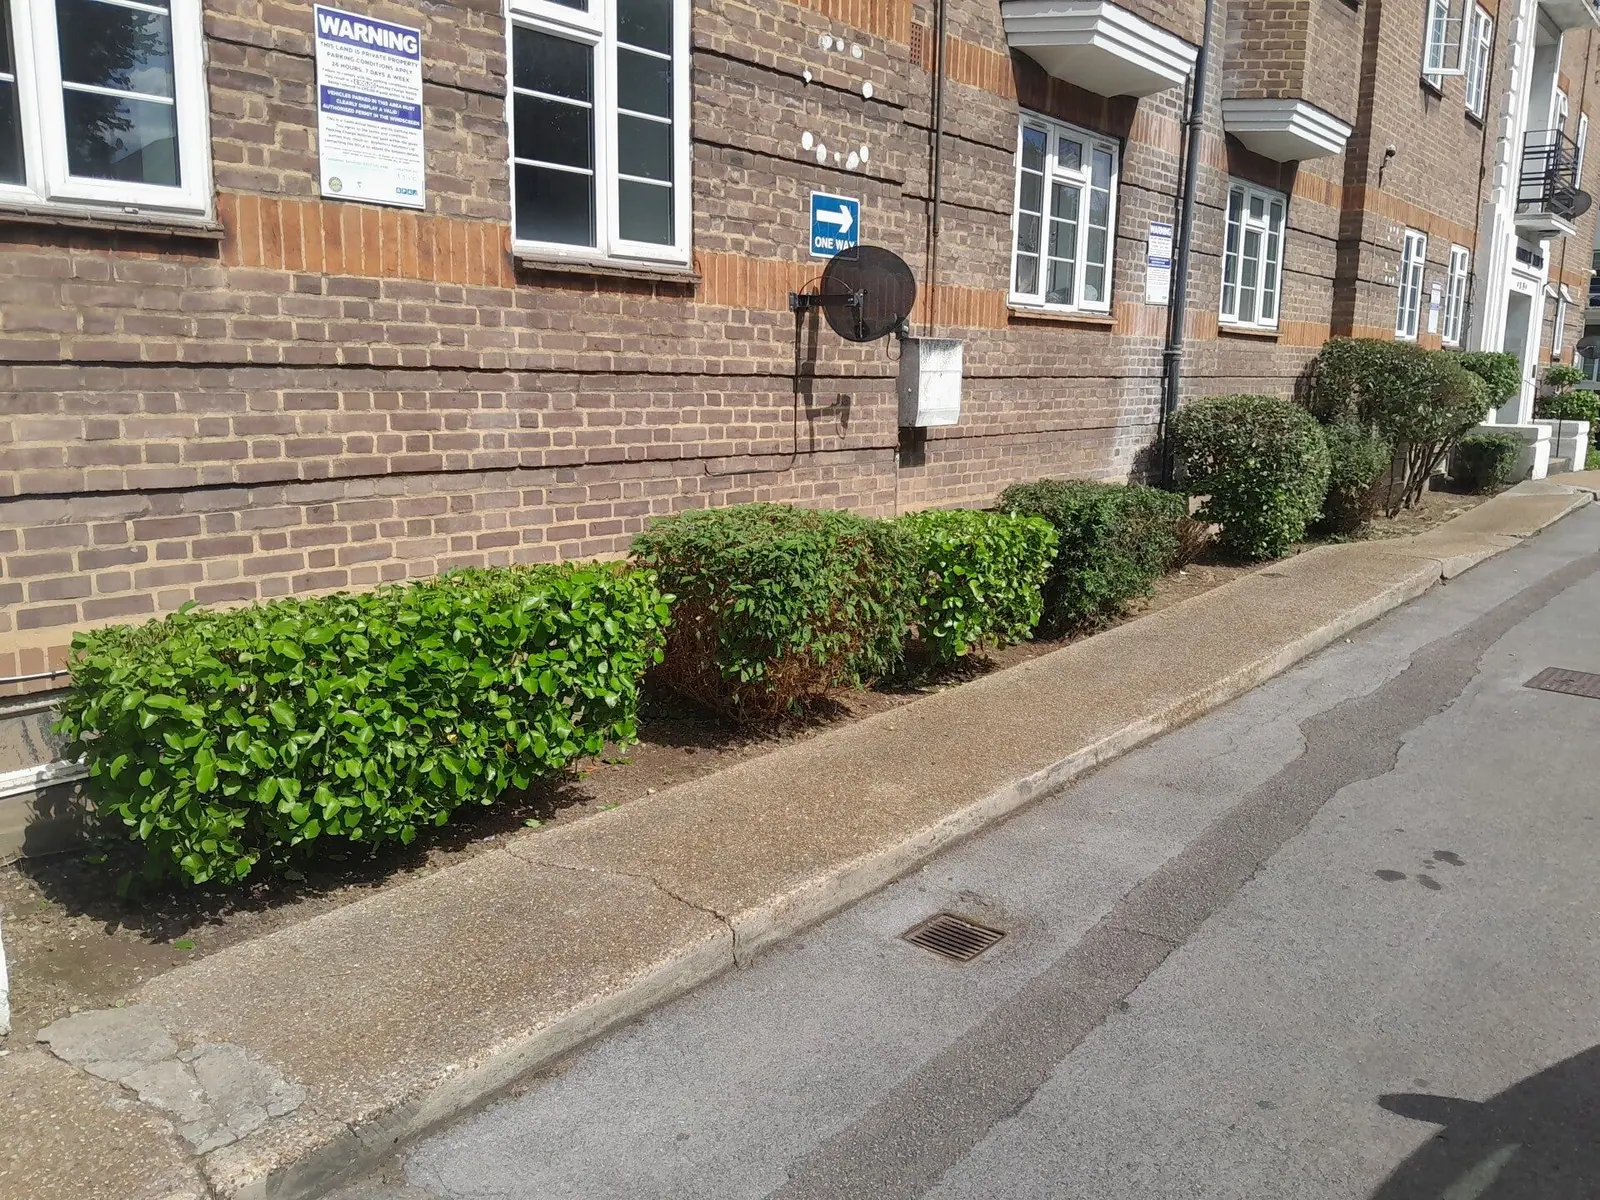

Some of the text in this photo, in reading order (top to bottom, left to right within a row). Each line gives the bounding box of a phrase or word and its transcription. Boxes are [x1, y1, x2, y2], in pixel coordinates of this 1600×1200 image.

[318, 13, 418, 54] WARNING
[320, 41, 334, 49] THIS
[335, 44, 353, 53] LAND
[361, 50, 386, 60] PRIVATE
[387, 56, 418, 68] PROPERTY
[326, 51, 412, 75] PARKING CONDITIONS APPLY
[370, 69, 385, 77] DAYS
[392, 74, 410, 83] WEEK
[327, 89, 351, 98] VEHICLES
[352, 94, 371, 103] PARKED
[402, 104, 416, 112] MUST
[335, 98, 358, 107] CLEARLY
[358, 102, 379, 111] DISPLAY
[383, 107, 398, 115] VALID
[322, 103, 355, 114] AUTHORISED
[355, 109, 373, 117] PERMIT
[389, 116, 420, 126] WINDSCREEN
[814, 236, 855, 250] ONE WAY
